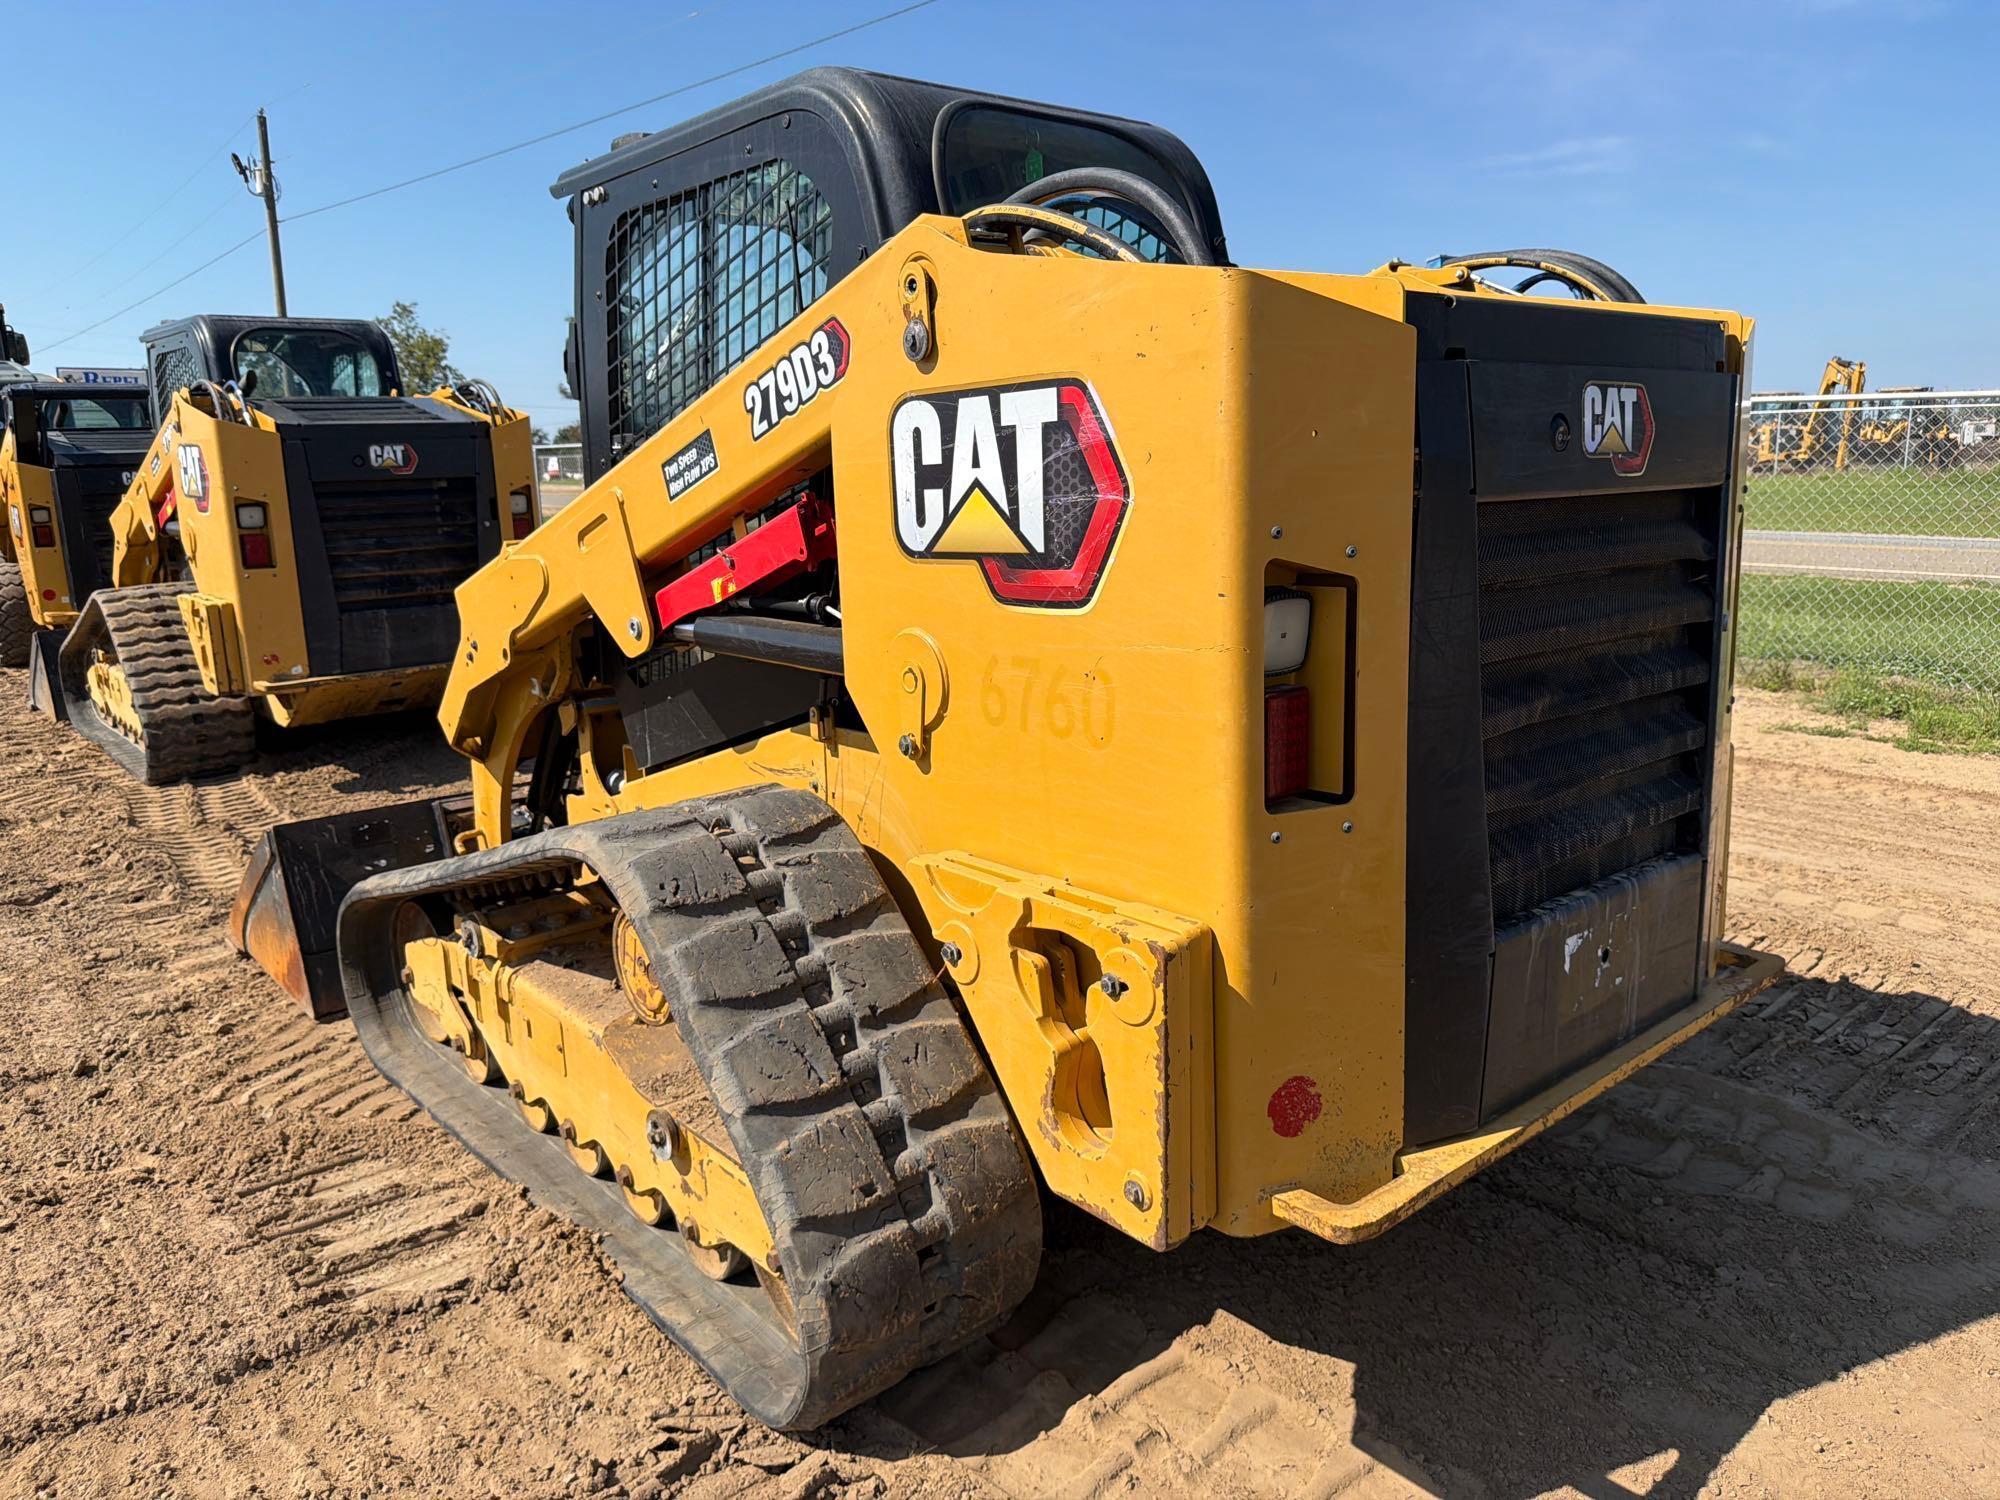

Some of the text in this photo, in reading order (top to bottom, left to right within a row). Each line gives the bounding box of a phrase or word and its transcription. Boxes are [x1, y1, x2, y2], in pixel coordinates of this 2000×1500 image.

[745, 330, 837, 439] 279D3
[1584, 385, 1637, 453] CAT
[178, 445, 203, 497] CAT
[370, 445, 404, 467] CAT
[700, 452, 715, 474] XPS
[892, 387, 1058, 553] CAT
[980, 655, 1116, 750] 6760
